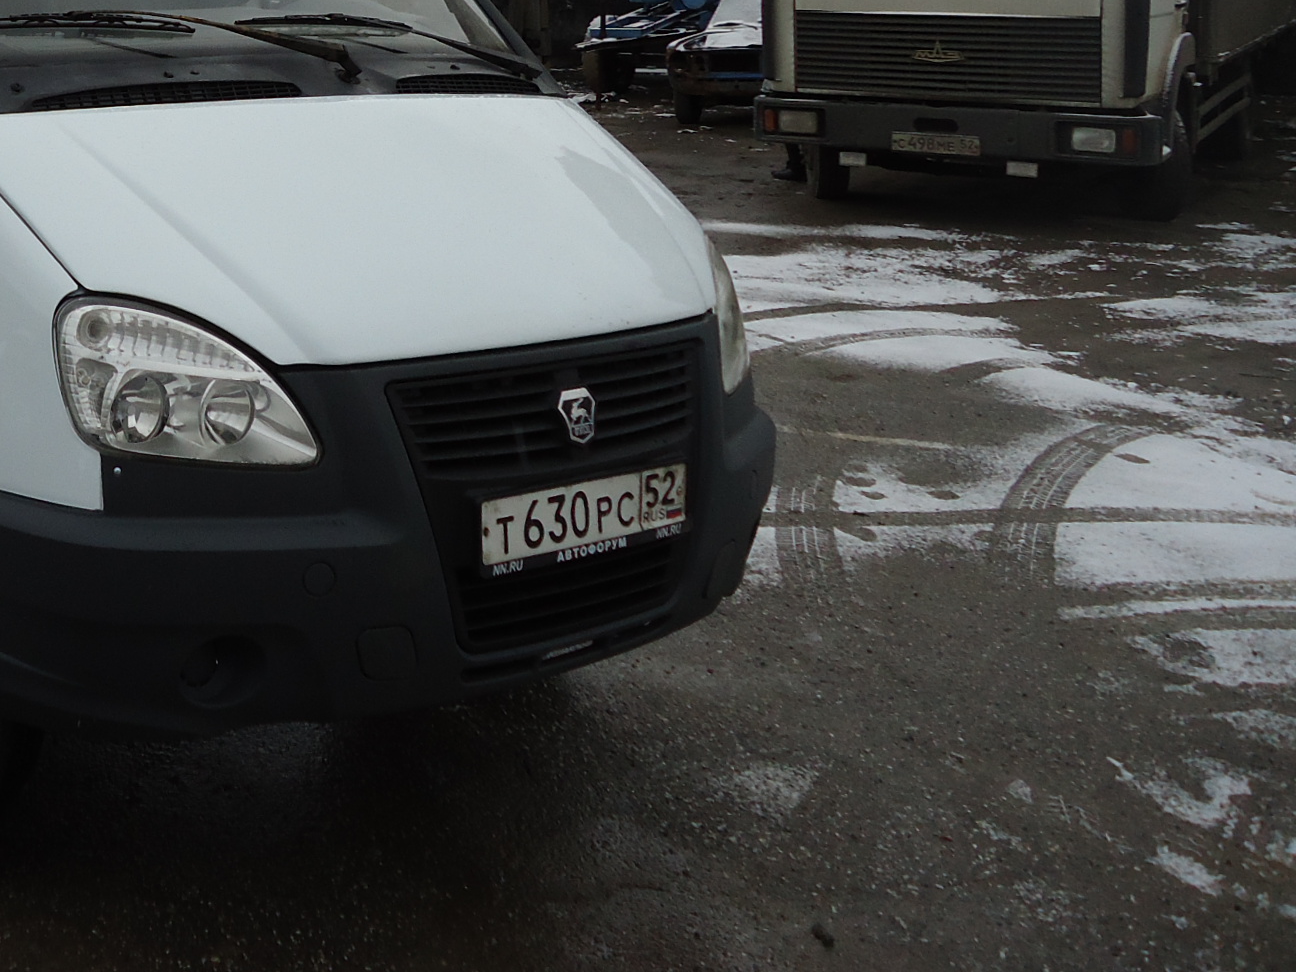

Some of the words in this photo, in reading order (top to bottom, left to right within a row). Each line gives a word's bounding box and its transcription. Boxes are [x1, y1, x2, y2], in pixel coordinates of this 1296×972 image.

[496, 490, 635, 555] Т630РС
[645, 471, 676, 508] 52
[643, 508, 666, 524] RUS
[656, 523, 682, 540] NN.RU
[557, 536, 627, 562] АВТОФОРУМ
[492, 559, 524, 577] NN.RU
